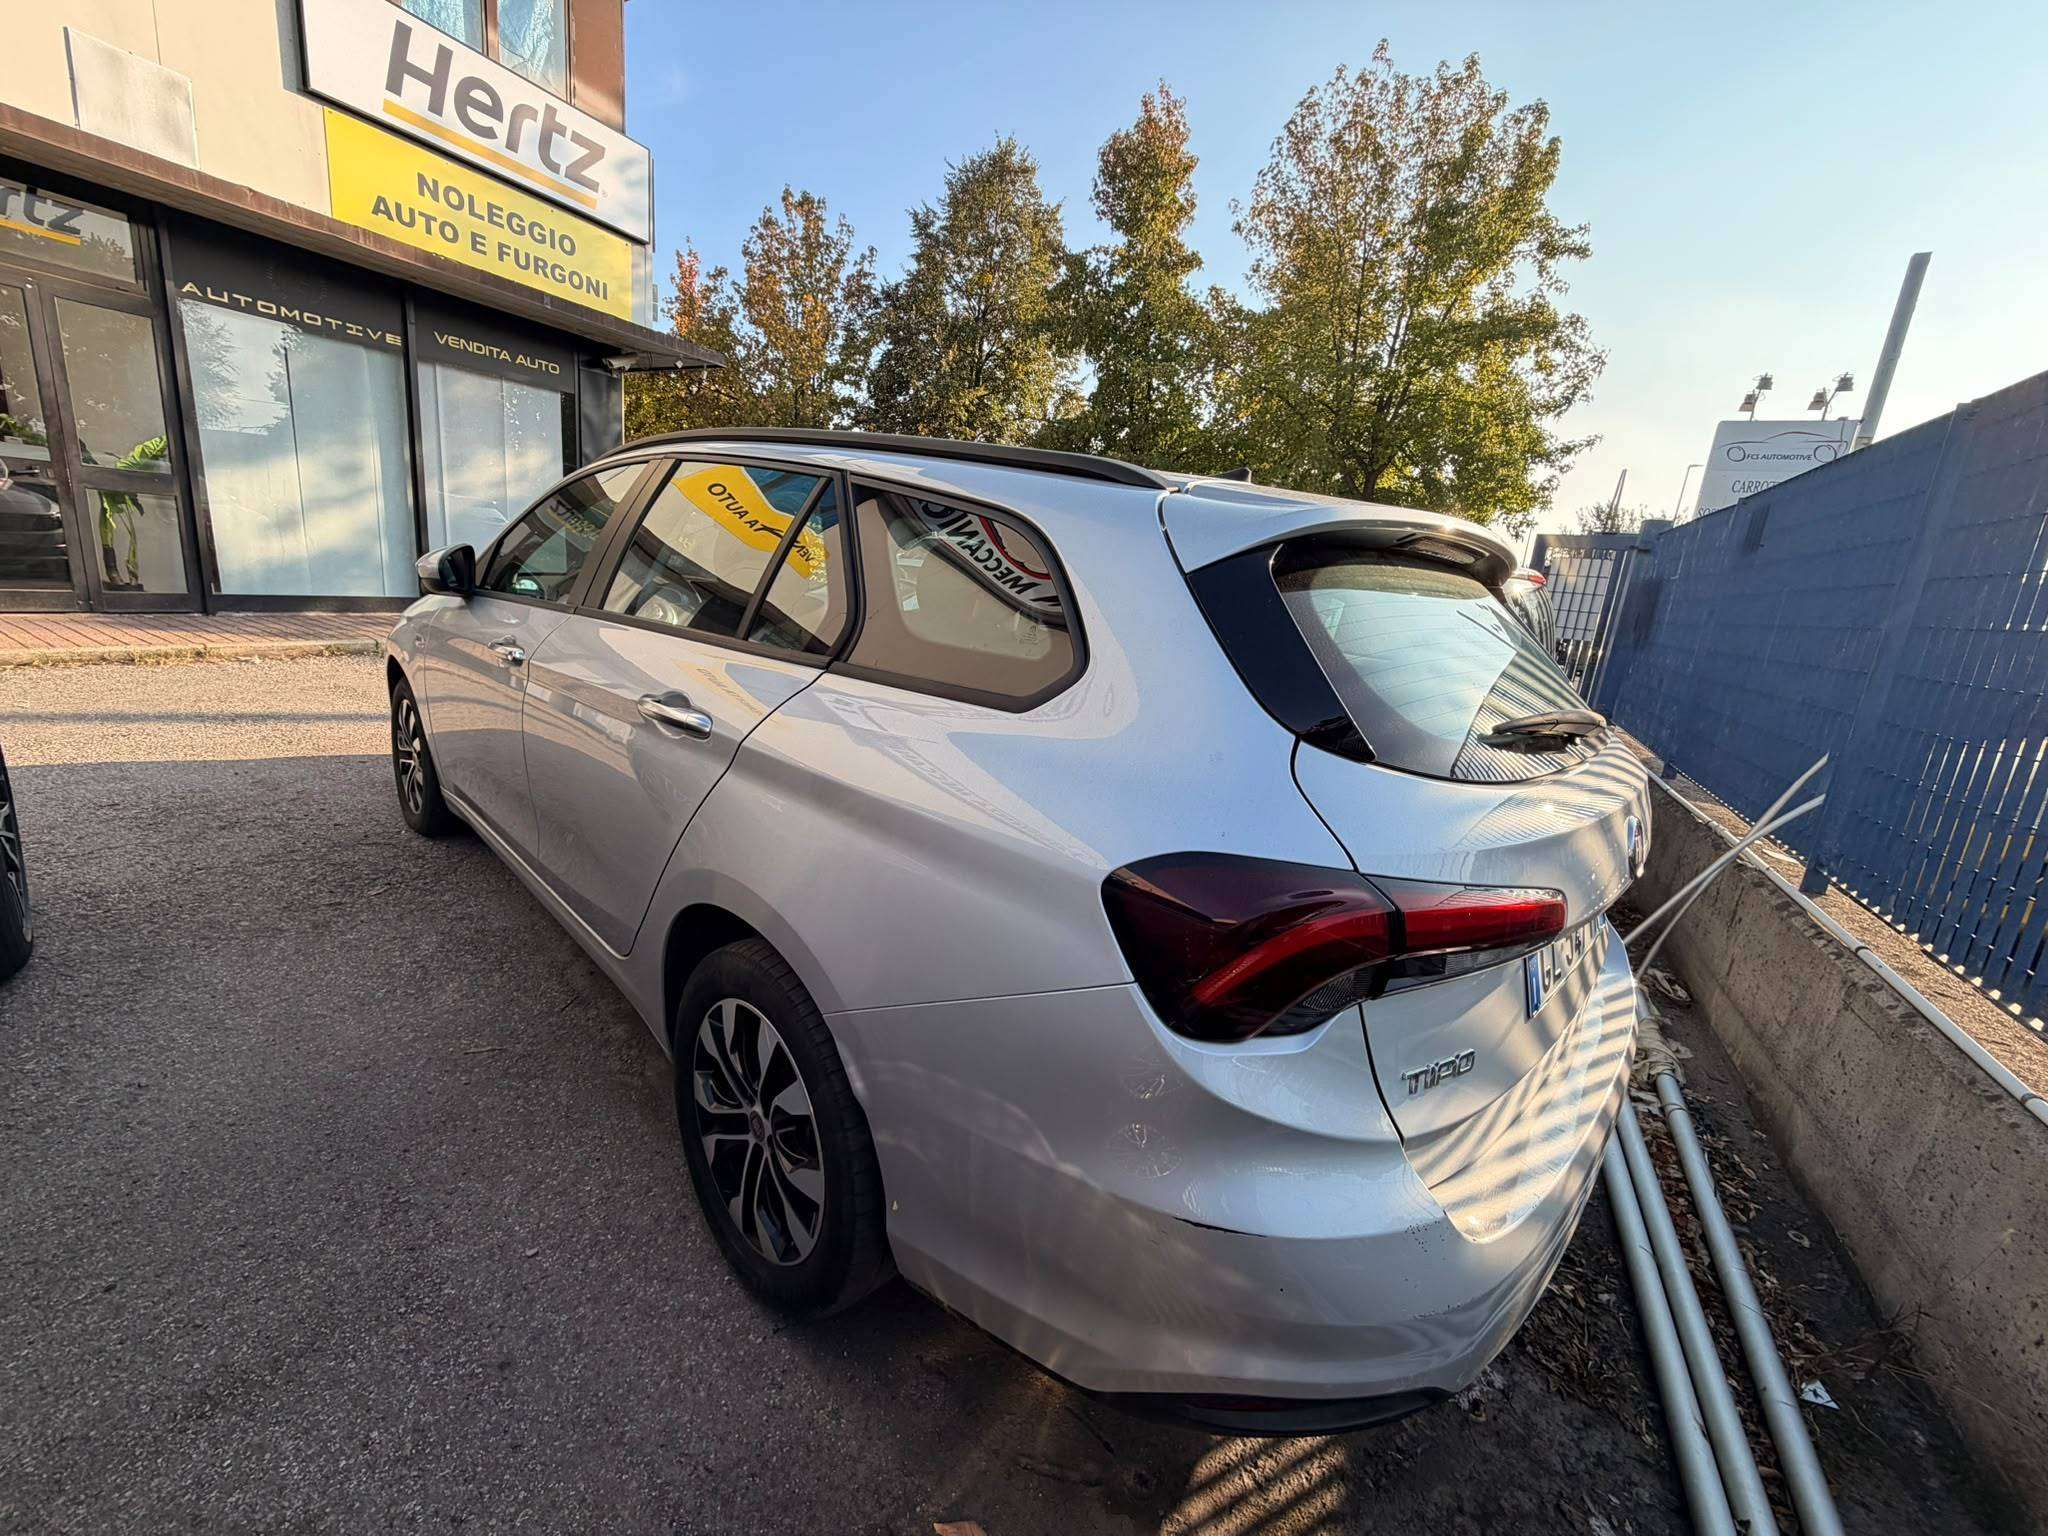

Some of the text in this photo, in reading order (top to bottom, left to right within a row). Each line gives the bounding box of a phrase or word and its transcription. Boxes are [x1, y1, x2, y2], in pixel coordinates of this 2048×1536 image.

[385, 19, 606, 194] Hertz
[0, 187, 84, 235] rtz
[416, 171, 577, 257] NOLEGGIO
[371, 195, 609, 301] AUTO E FURGONI
[181, 281, 403, 347] AUTOMOTIVE
[433, 330, 561, 375] VENDITA AUTO
[1731, 480, 1780, 493] CARRO
